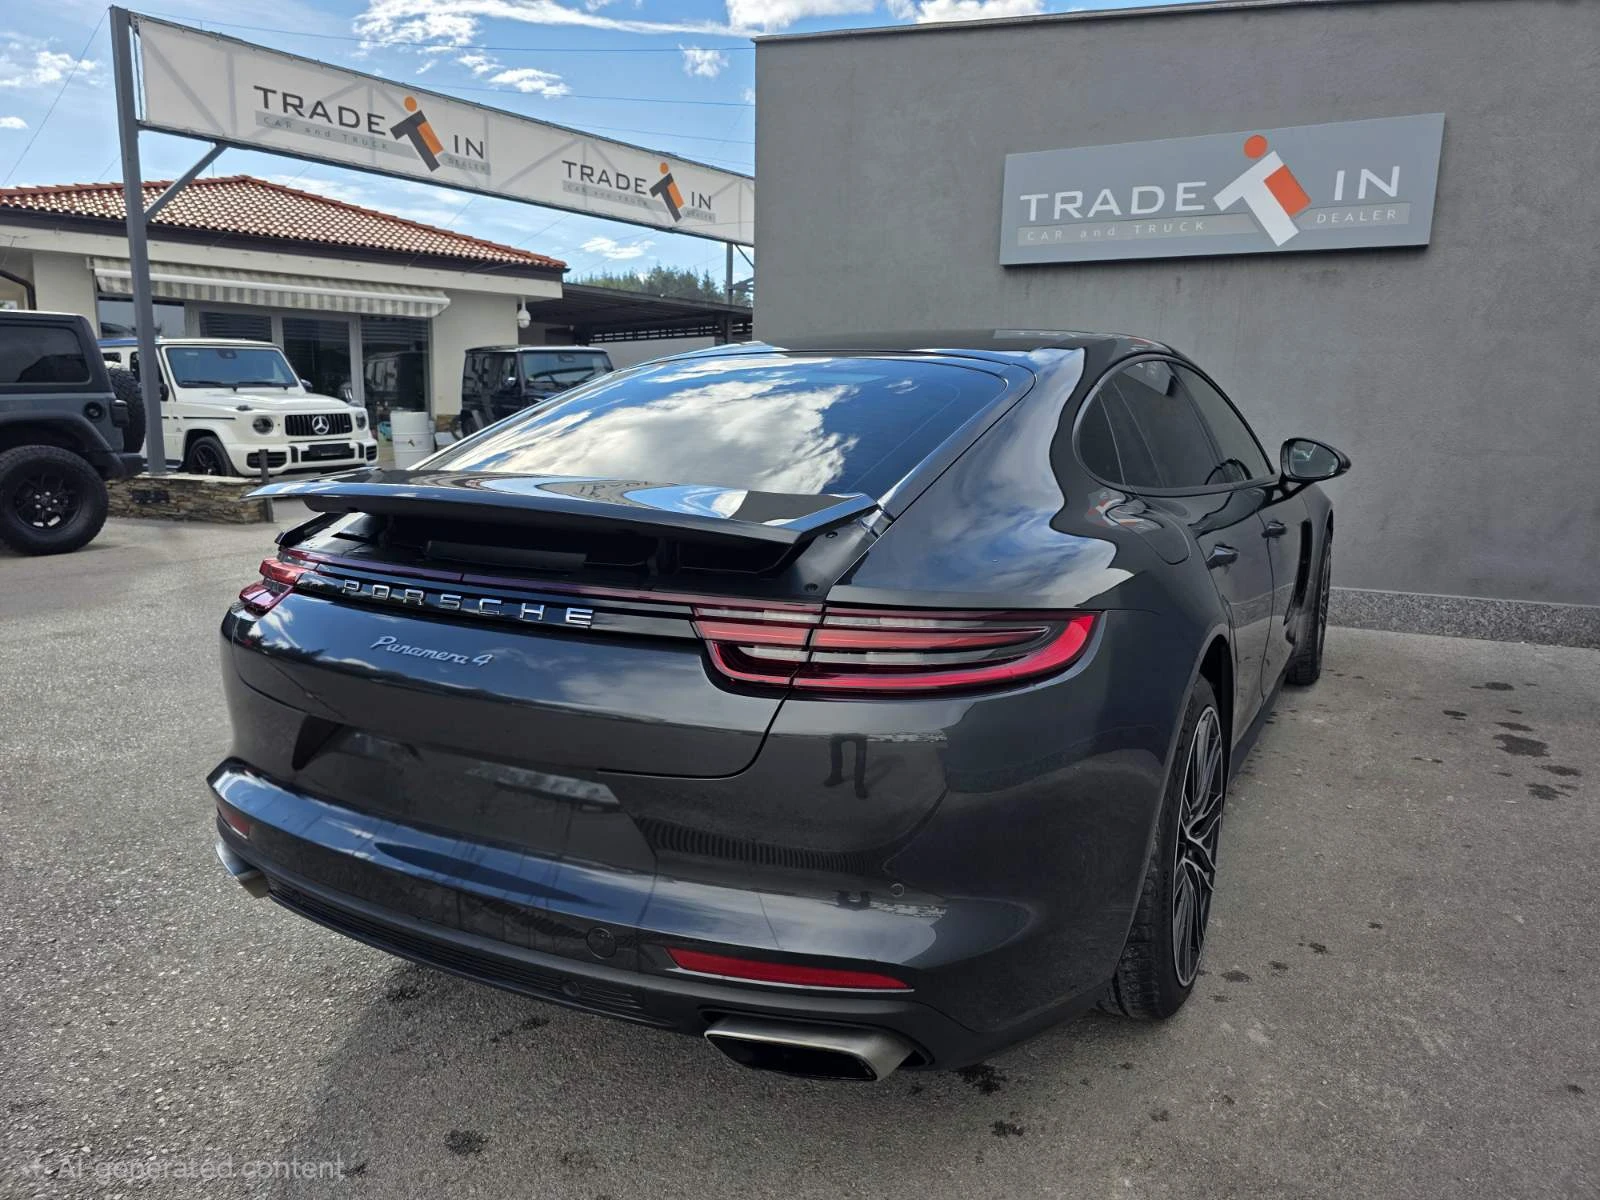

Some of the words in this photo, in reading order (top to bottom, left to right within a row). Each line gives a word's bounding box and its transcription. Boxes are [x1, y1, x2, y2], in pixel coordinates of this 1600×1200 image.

[253, 85, 386, 136] TRADE
[453, 134, 485, 160] IN
[562, 160, 647, 195] TRADE
[691, 191, 712, 210] IN
[1020, 181, 1207, 222] TRADE
[1334, 166, 1400, 200] IN
[1027, 230, 1063, 241] CAR
[1080, 227, 1116, 240] and
[1134, 221, 1205, 235] TRUCK
[1316, 209, 1397, 224] DEALER
[341, 579, 595, 627] PORSCHE
[369, 635, 469, 665] Panamera
[471, 653, 494, 667] 4
